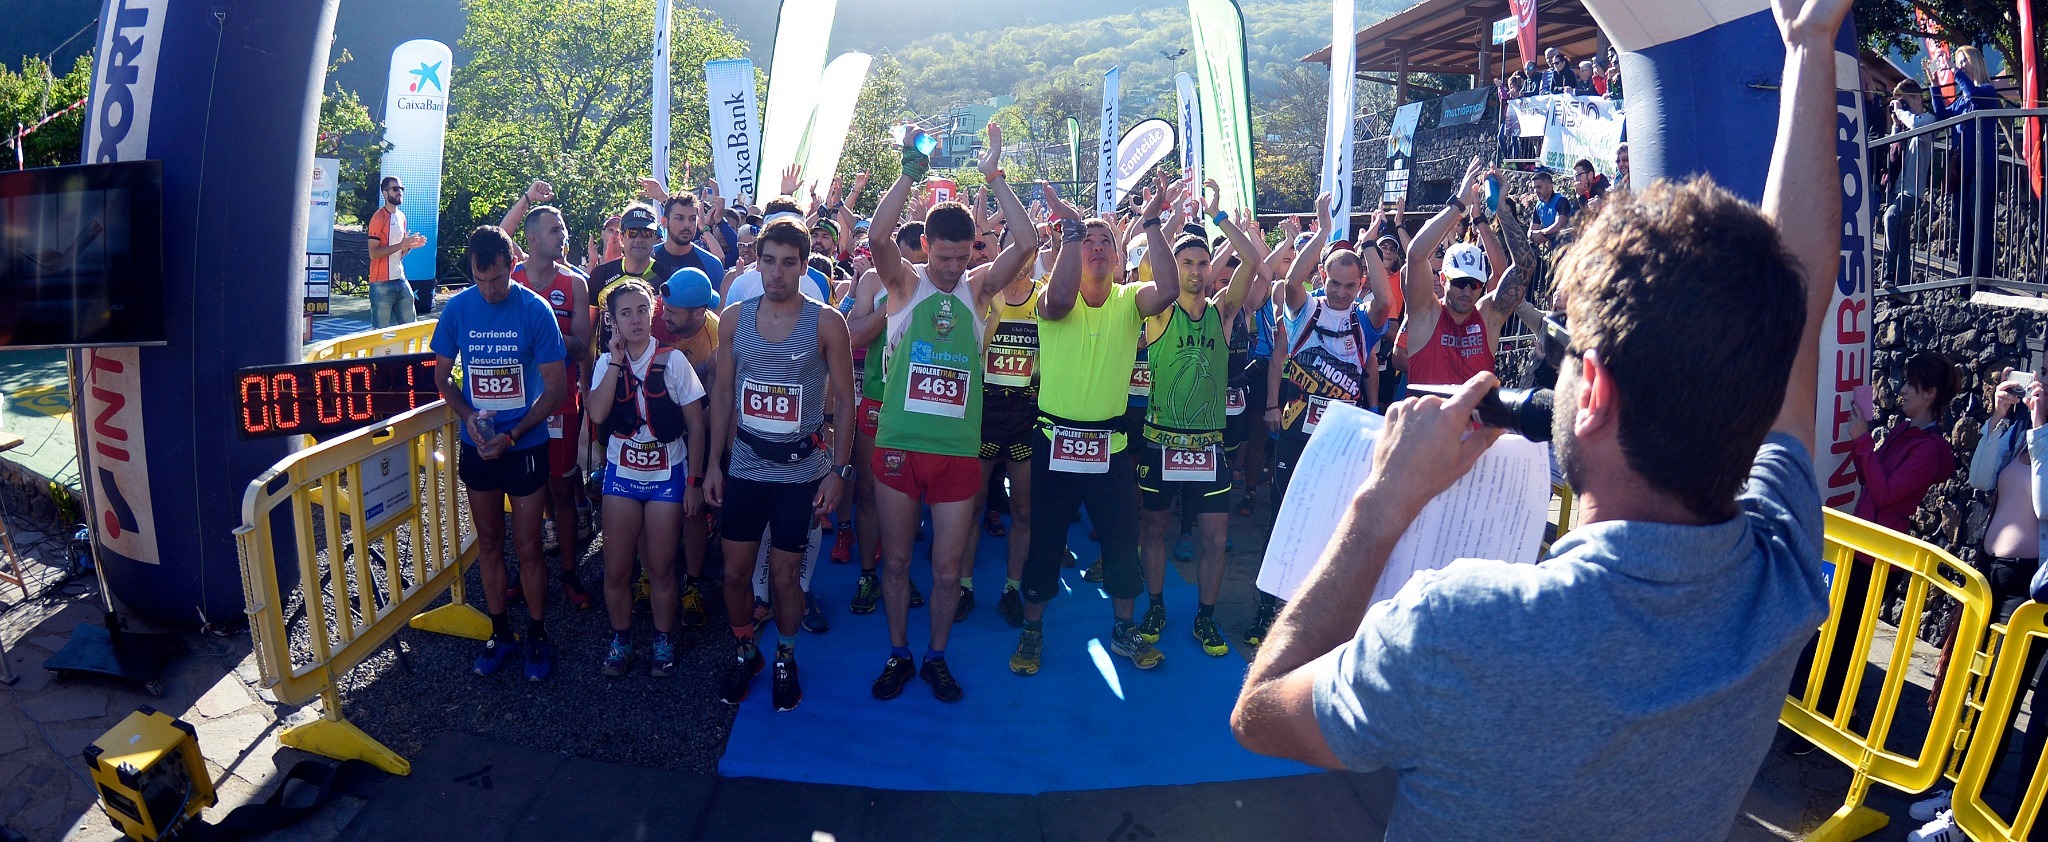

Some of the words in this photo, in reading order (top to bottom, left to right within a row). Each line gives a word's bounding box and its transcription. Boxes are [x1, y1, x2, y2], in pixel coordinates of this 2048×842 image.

[1119, 129, 1163, 177] Fonteide
[633, 210, 648, 219] TRAIL
[469, 330, 518, 339] Corriendo
[468, 344, 485, 352] por
[487, 344, 493, 353] y
[495, 344, 518, 353] para
[469, 356, 519, 365] Jesucristo
[993, 355, 1027, 371] 417
[478, 377, 514, 393] 582
[918, 377, 958, 397] 463
[750, 393, 789, 414] 618
[1062, 439, 1099, 456] 595
[1191, 435, 1215, 446] MAX
[626, 449, 661, 466] 652
[1171, 451, 1207, 465] 433
